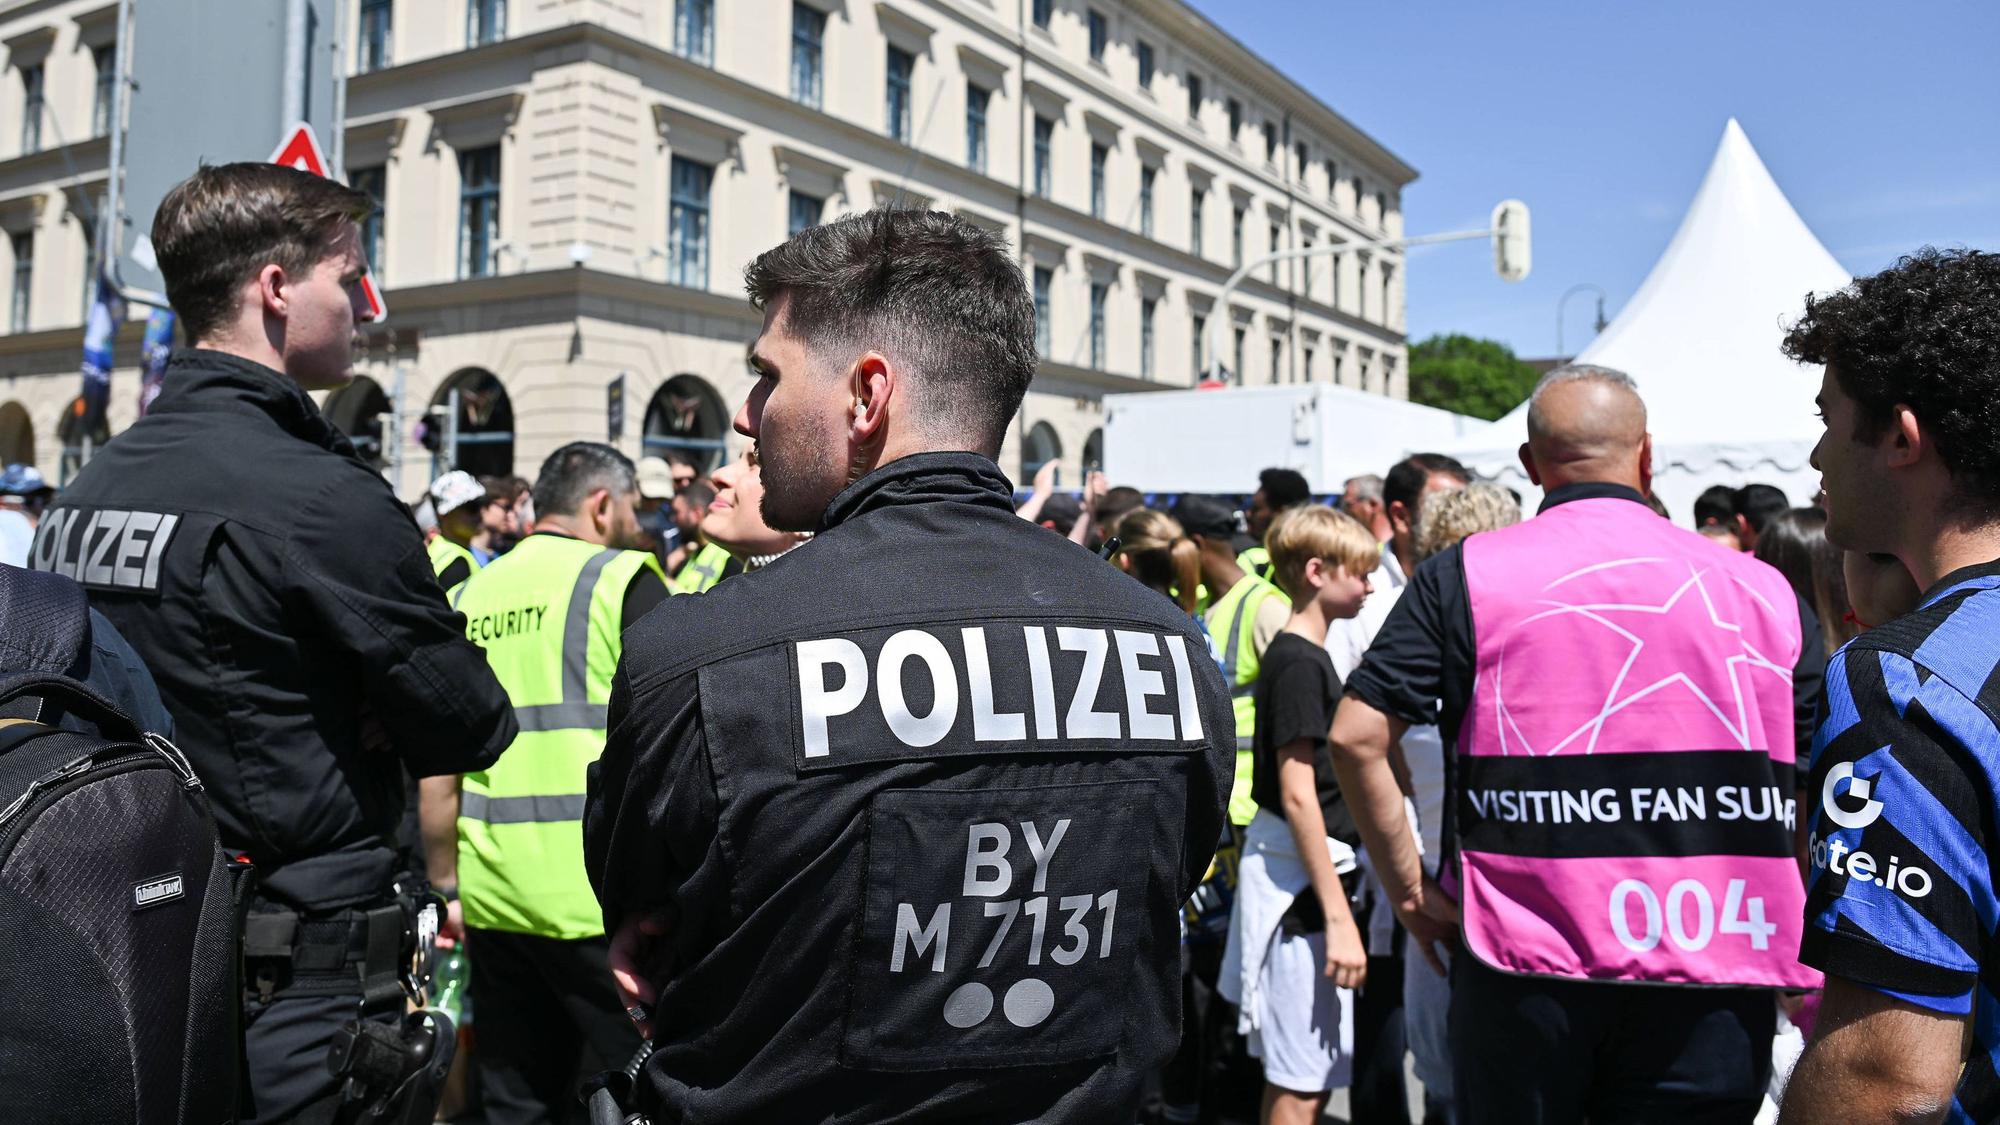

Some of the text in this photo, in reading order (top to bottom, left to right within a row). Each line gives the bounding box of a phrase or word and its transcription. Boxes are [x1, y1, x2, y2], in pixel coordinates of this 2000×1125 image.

[29, 507, 178, 589] OLIZEI
[470, 605, 547, 642] ECURITY
[796, 626, 1205, 758] POLIZEI
[1467, 788, 1621, 824] VISITING
[1630, 786, 1706, 822] FAN
[963, 818, 1072, 897] BY
[889, 889, 1119, 973] M 7131
[1608, 878, 1777, 952] 004
